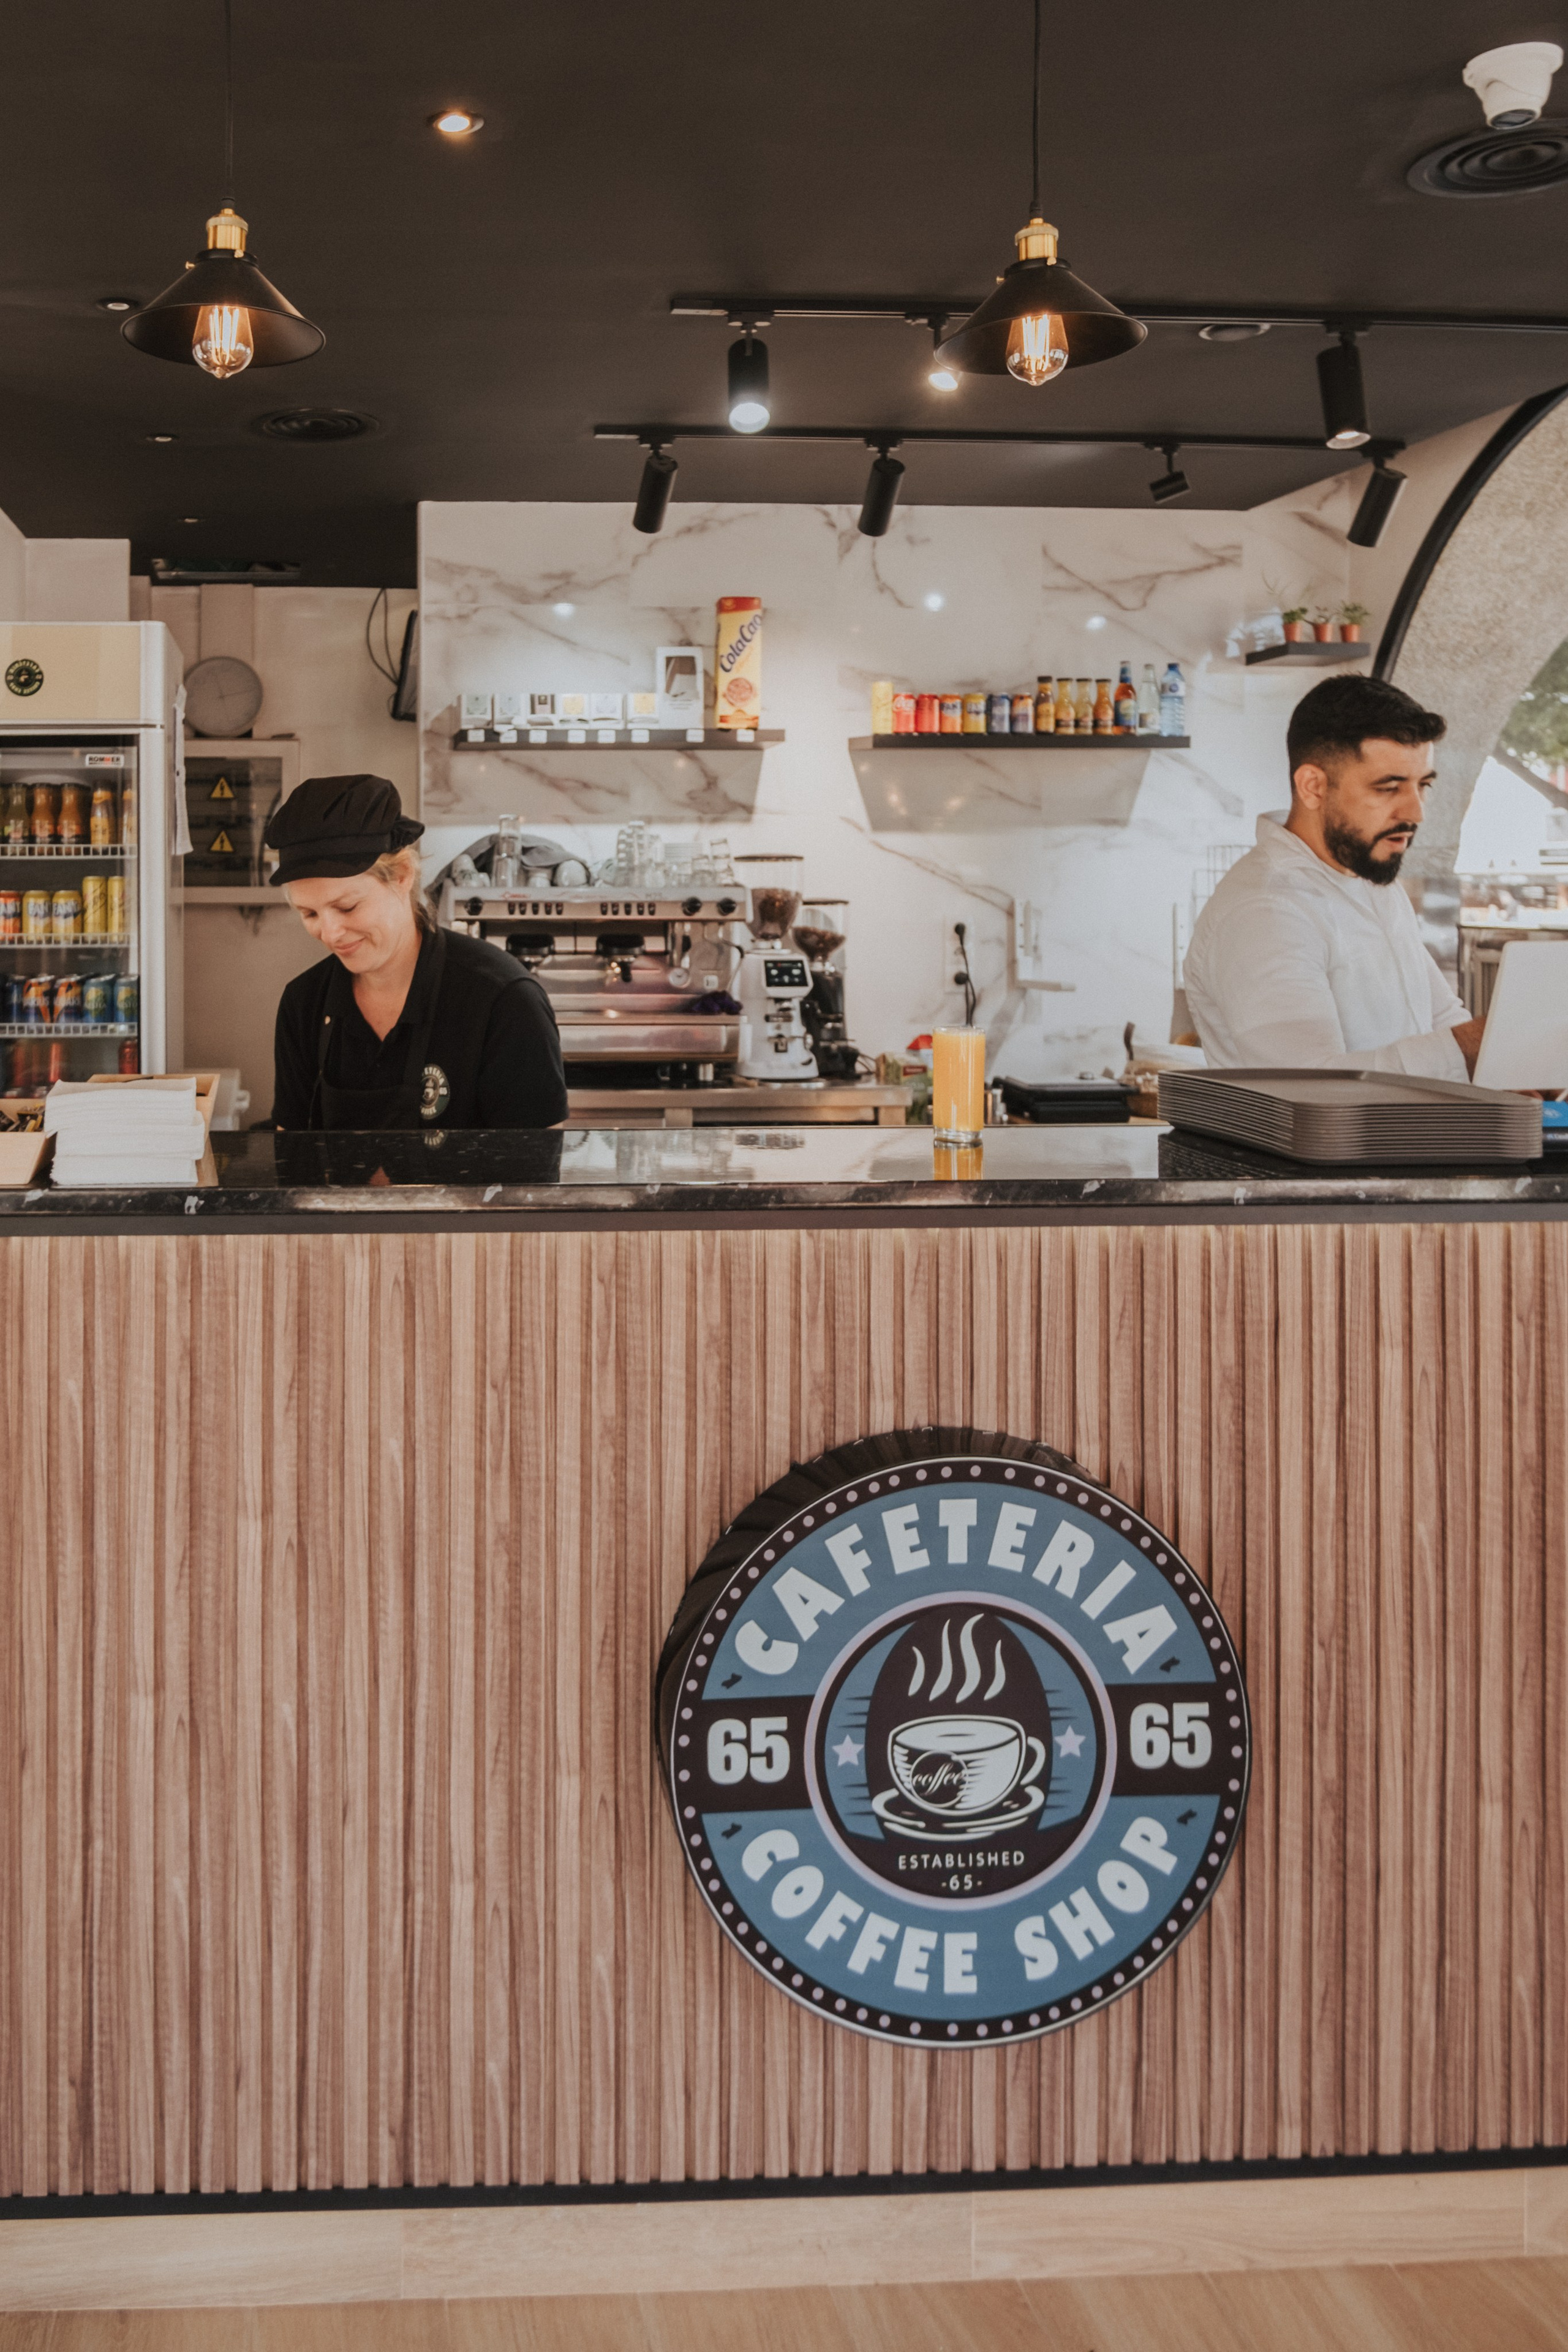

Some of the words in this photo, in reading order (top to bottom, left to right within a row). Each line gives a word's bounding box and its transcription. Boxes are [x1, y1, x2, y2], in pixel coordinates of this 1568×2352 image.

[720, 614, 763, 673] ColaCao
[735, 1499, 1178, 1675] CAFETERIA
[706, 1716, 790, 1784] 65
[1129, 1701, 1212, 1769] 65
[911, 1762, 965, 1796] coffee
[898, 1850, 1025, 1870] ESTABLISHED
[742, 1829, 978, 1995] COFFEE
[1014, 1816, 1178, 1981] SHOP
